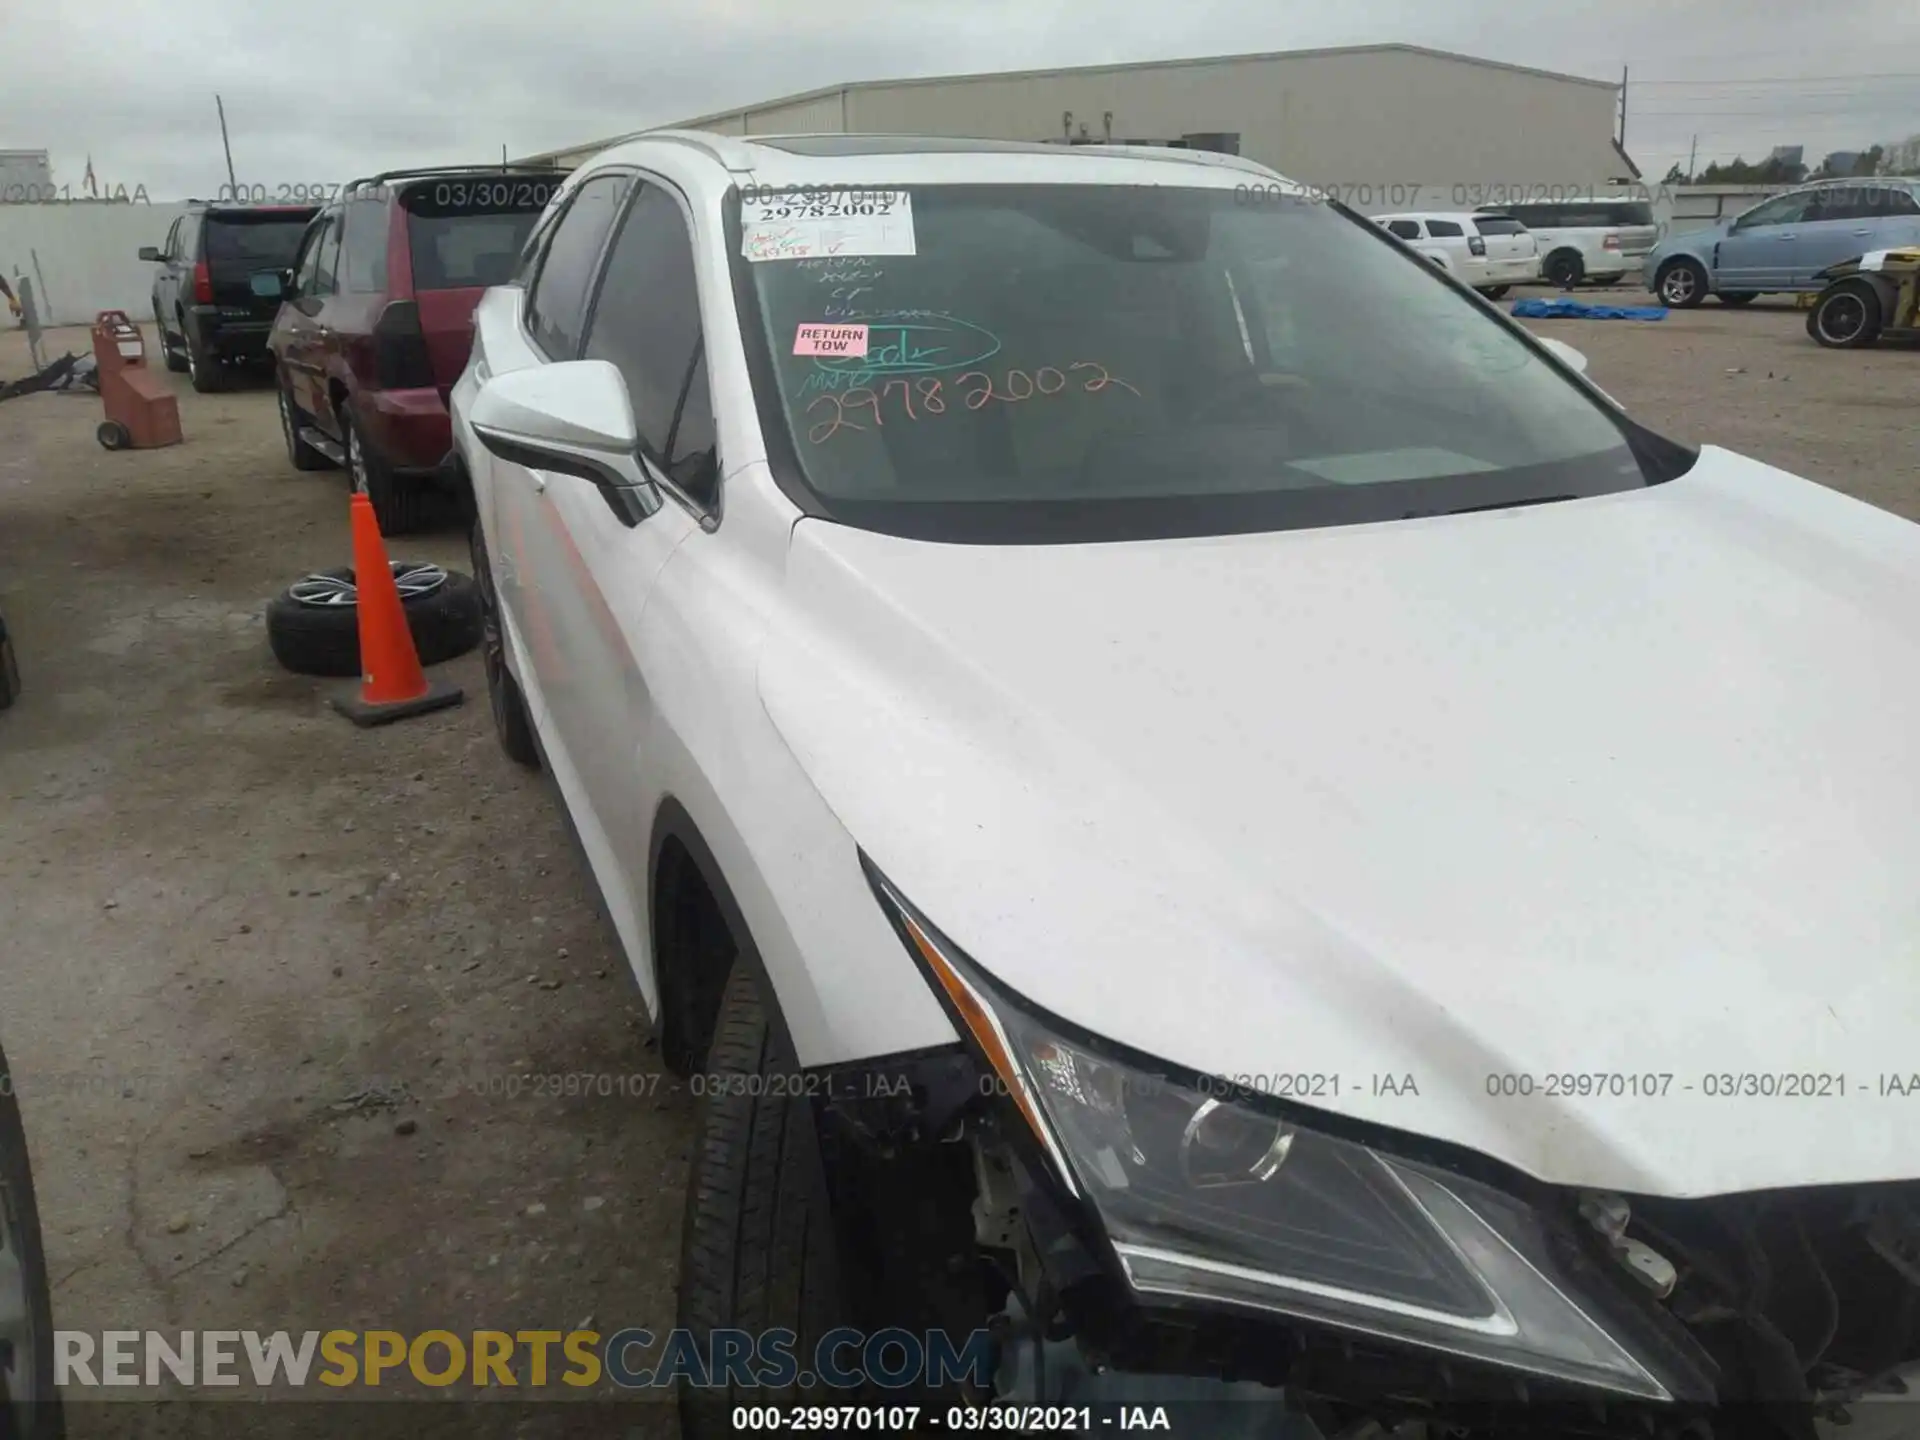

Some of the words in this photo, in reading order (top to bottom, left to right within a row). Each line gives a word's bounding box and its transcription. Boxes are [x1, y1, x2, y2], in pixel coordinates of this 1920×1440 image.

[760, 204, 891, 221] 29782002
[801, 328, 863, 340] RETURN
[813, 340, 848, 351] TOW
